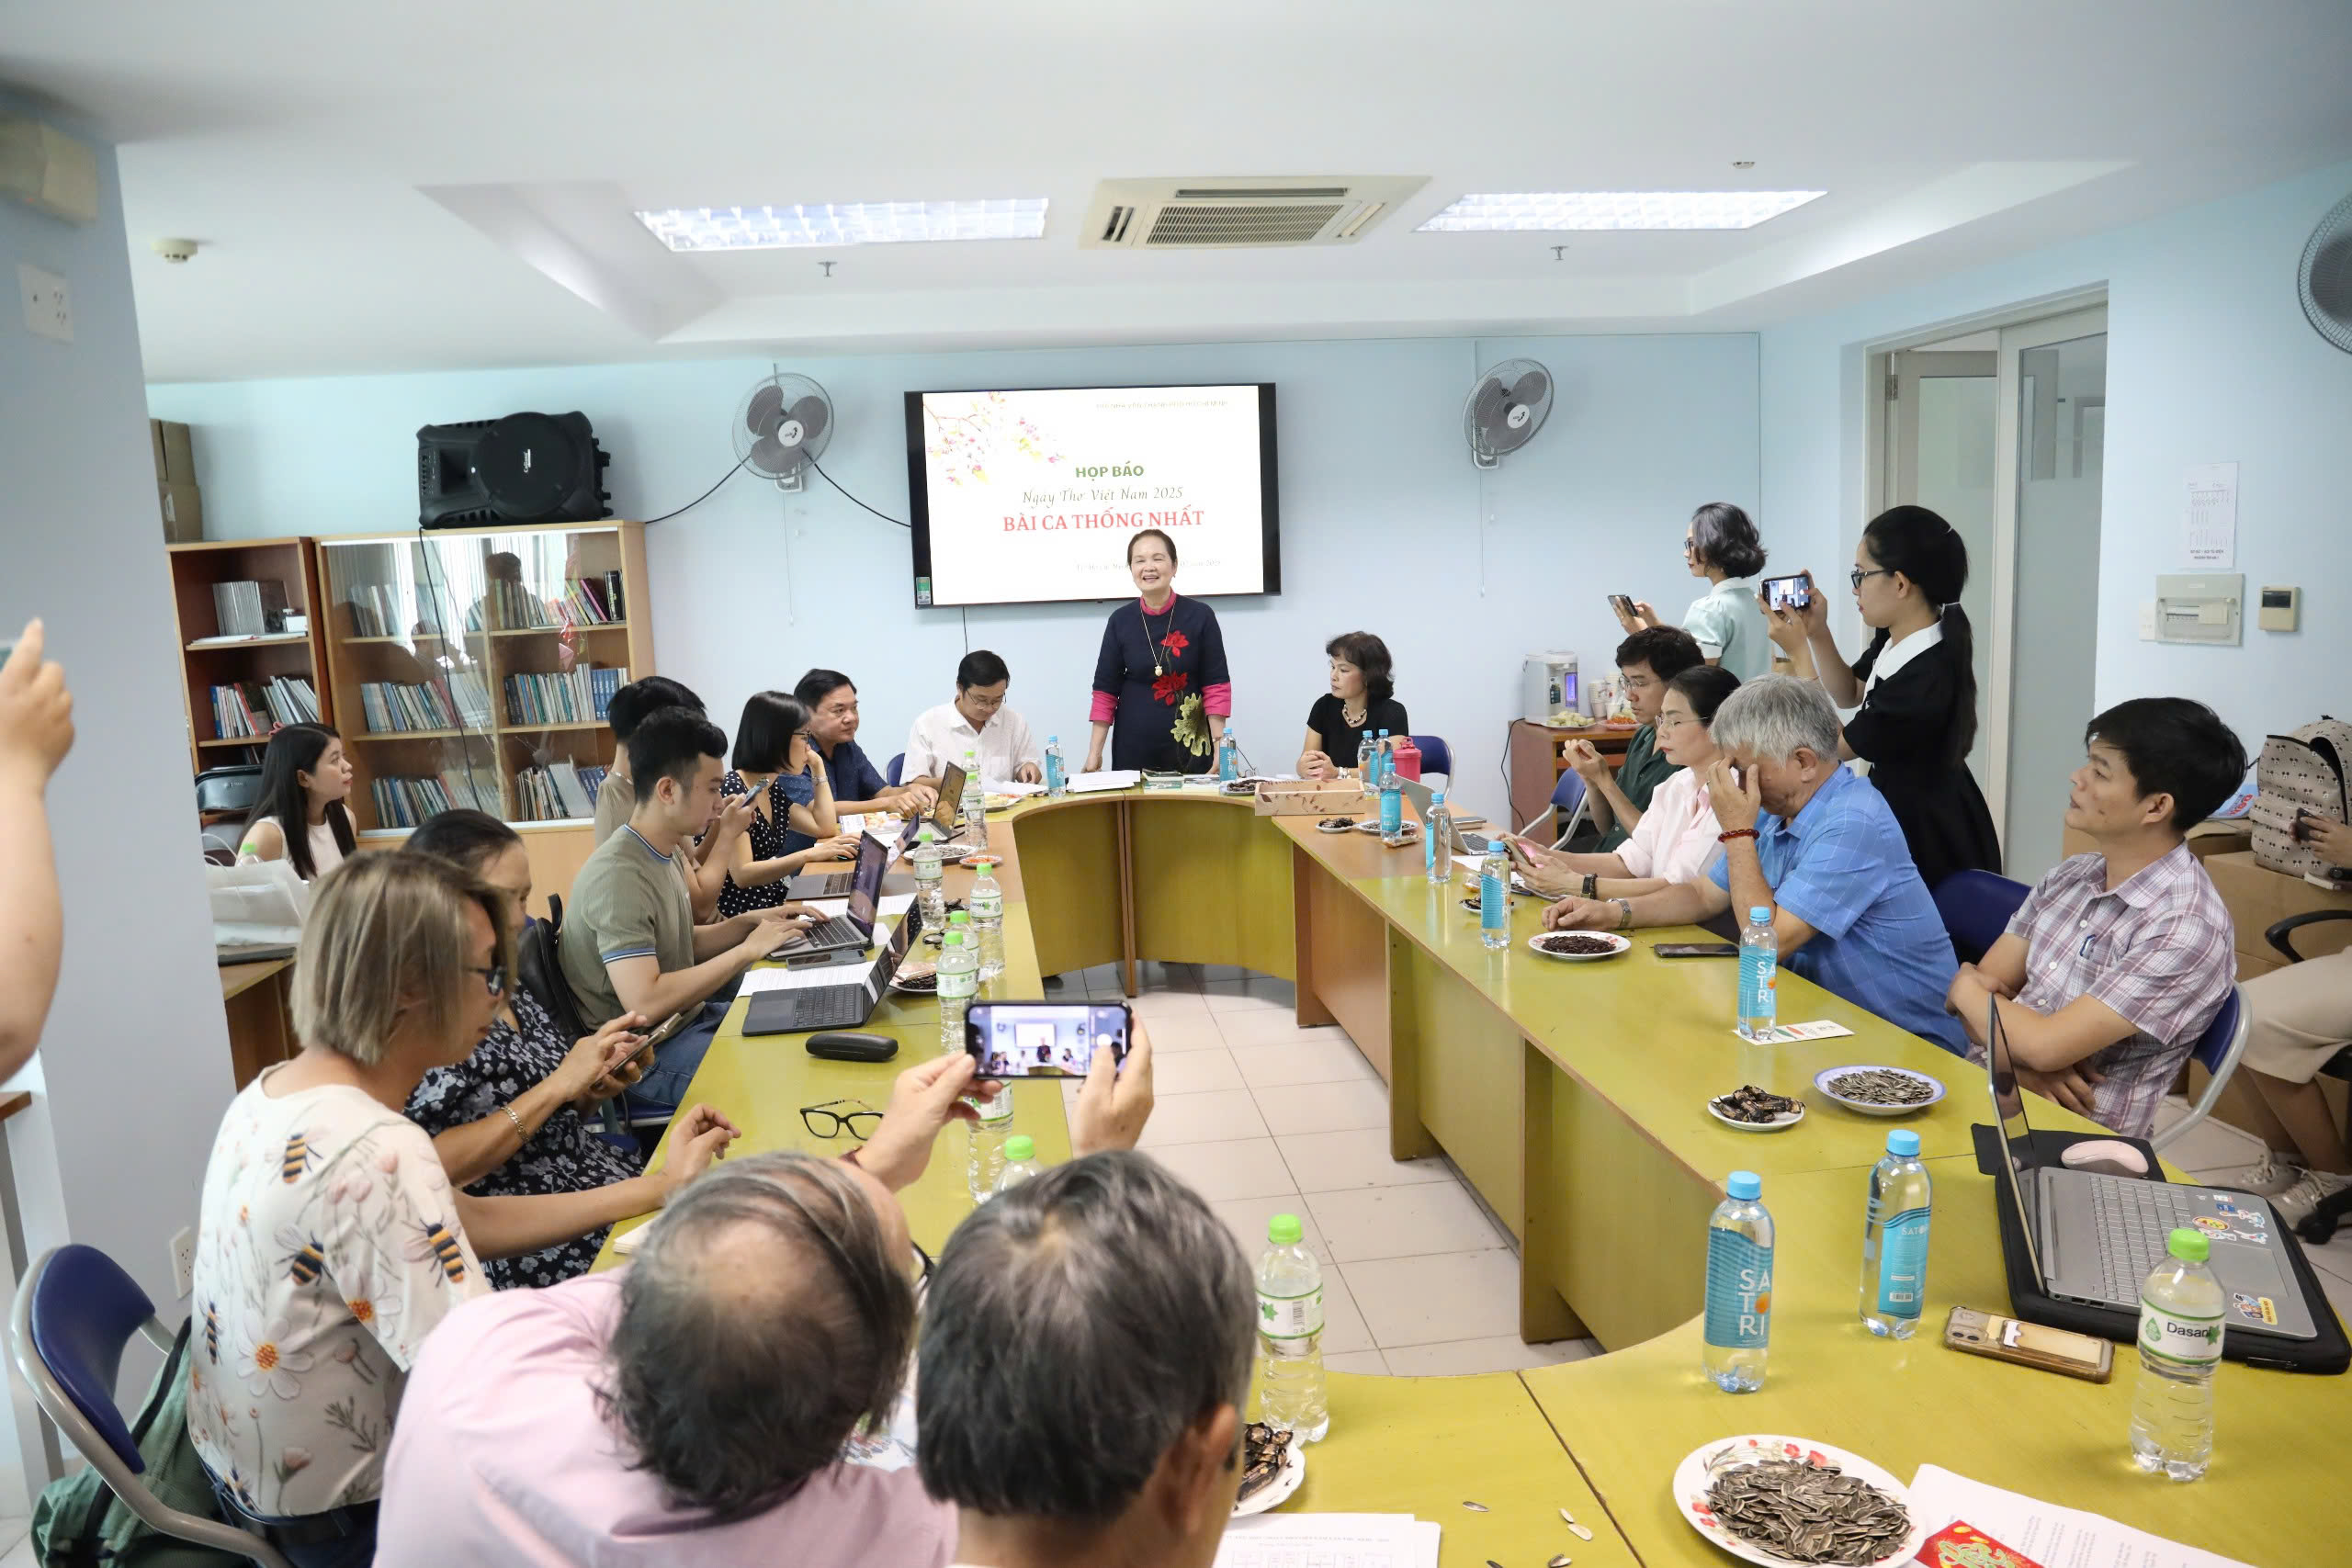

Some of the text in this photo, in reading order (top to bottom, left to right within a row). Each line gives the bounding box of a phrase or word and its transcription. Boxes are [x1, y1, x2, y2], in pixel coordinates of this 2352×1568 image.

[1076, 461, 1144, 481] HỌP BÁO
[1121, 486, 1148, 501] Nam
[1153, 487, 1183, 499] 2025
[1003, 504, 1204, 531] BÀI CA THỐNG NHẤT
